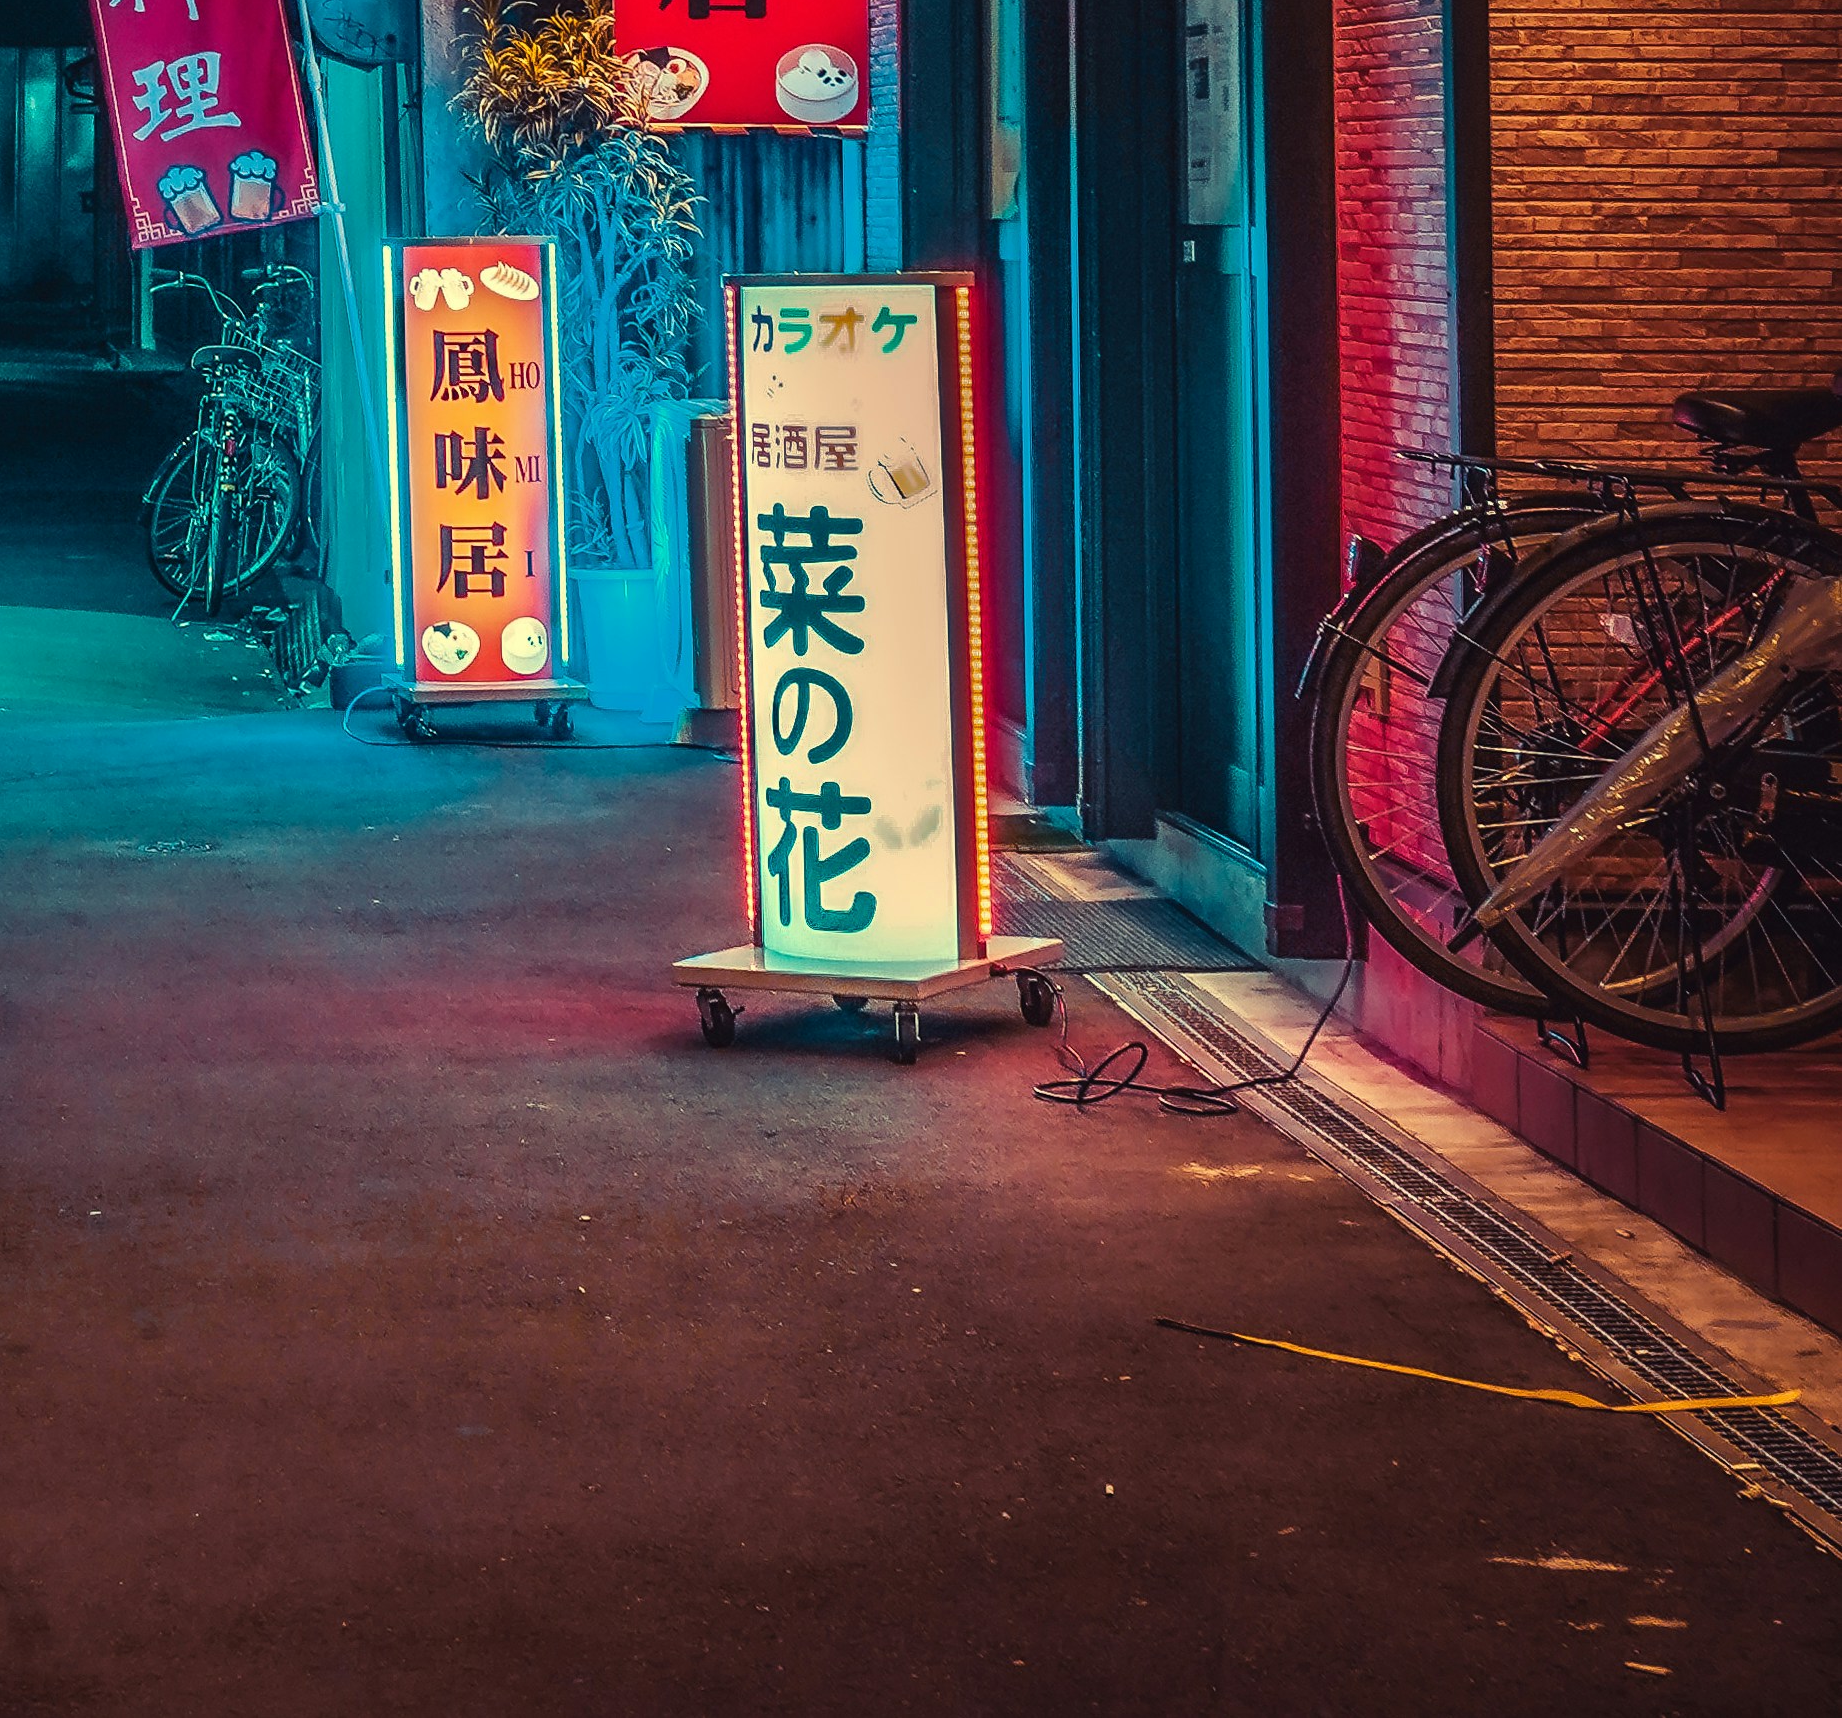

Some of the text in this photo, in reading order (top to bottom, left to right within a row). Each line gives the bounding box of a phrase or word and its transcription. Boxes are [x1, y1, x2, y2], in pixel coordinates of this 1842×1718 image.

[751, 305, 918, 355] カラオケ
[429, 328, 509, 599] 鳳味居
[508, 360, 542, 578] HO MI I
[751, 422, 859, 470] 居酒屋
[757, 502, 877, 934] 菜の花
